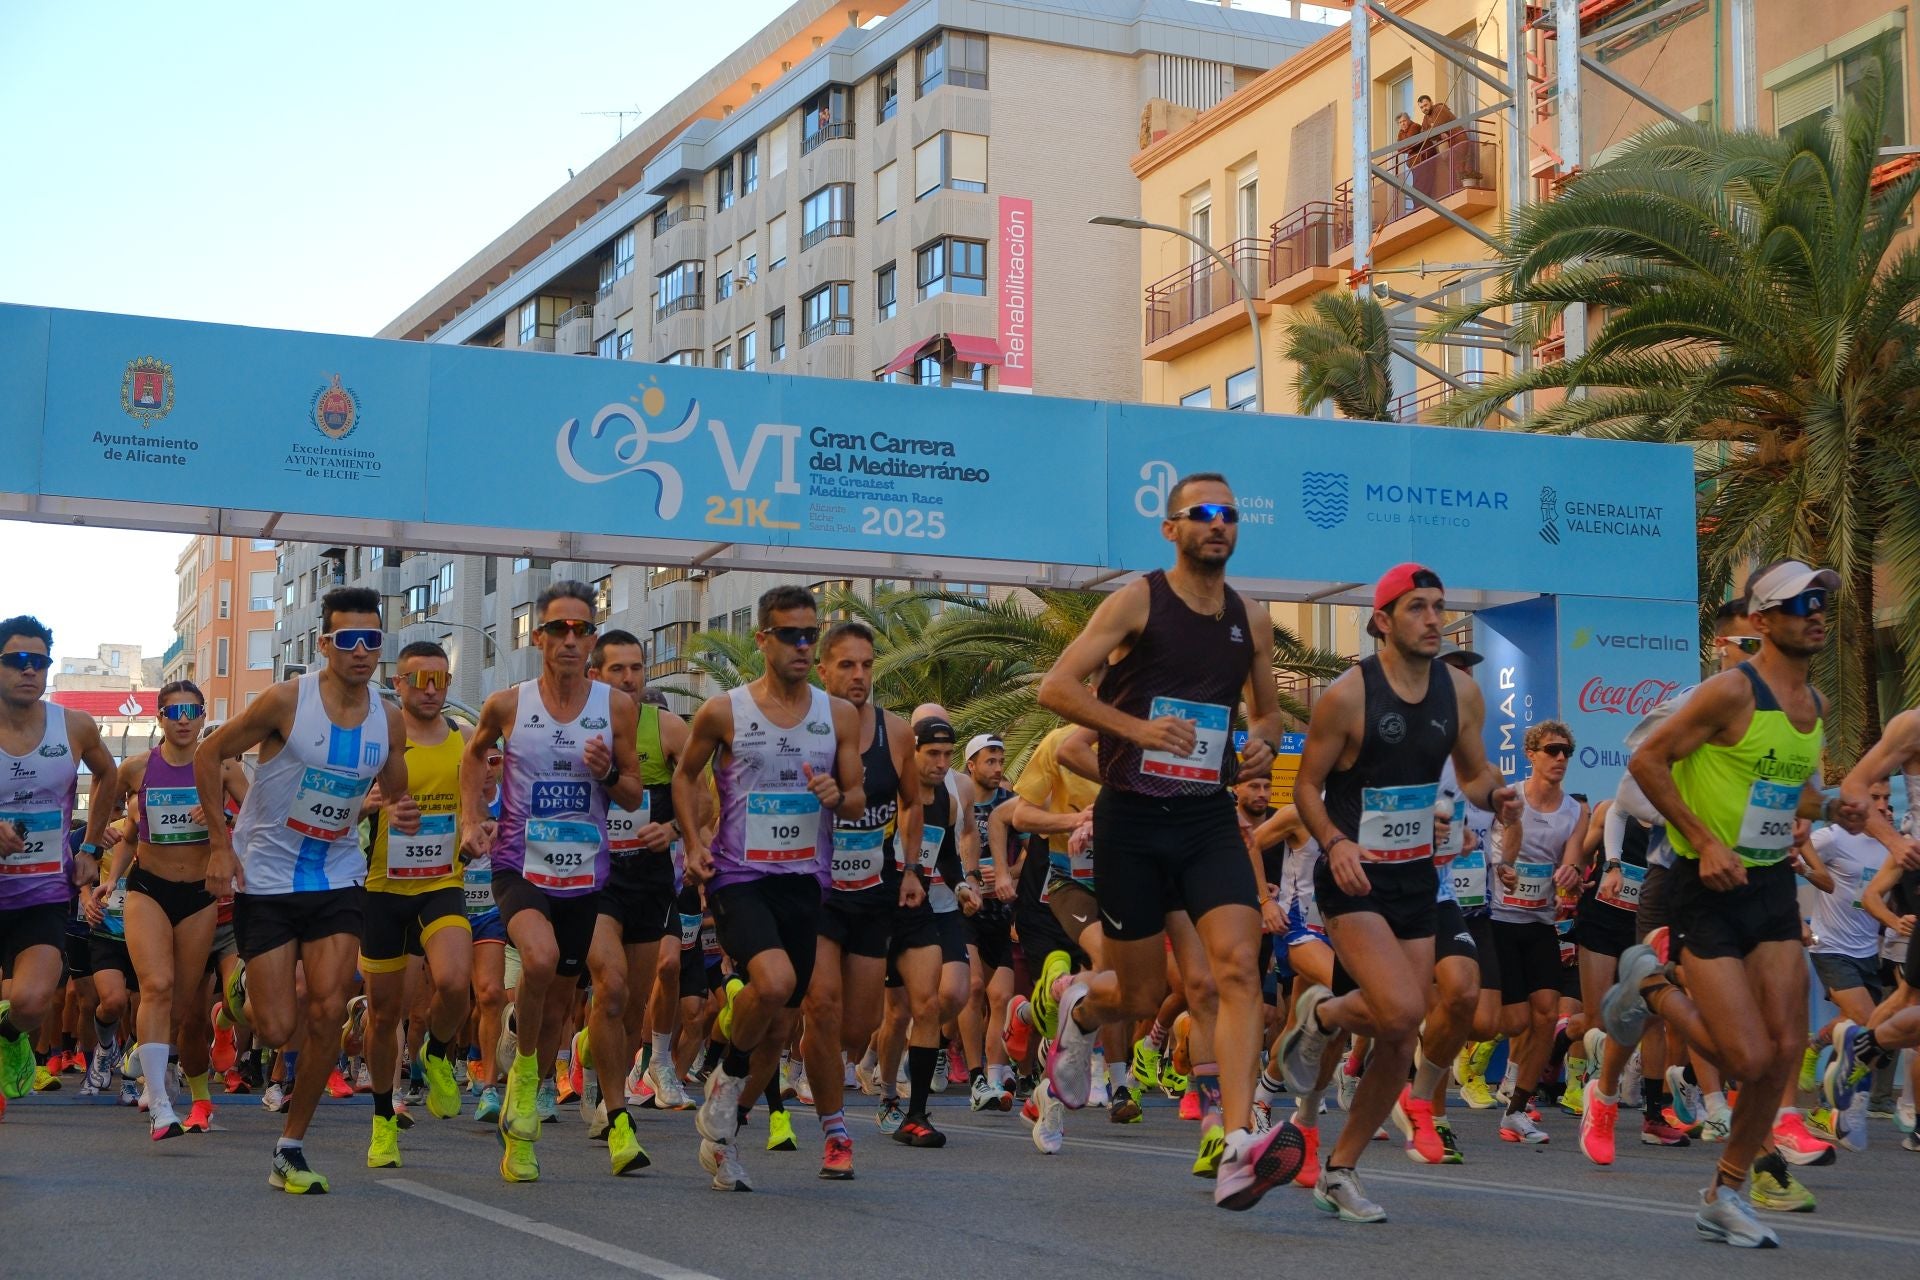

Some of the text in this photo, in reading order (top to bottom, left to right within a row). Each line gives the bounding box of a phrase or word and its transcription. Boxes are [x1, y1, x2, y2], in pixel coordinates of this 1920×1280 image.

[1004, 210, 1024, 369] Rehabilitación
[92, 431, 199, 452] Ayuntamiento
[809, 427, 956, 457] Gran Carrera
[103, 448, 187, 466] de Alicante
[285, 455, 382, 471] AYUNTAMIENTO
[708, 420, 801, 495] VI
[306, 467, 360, 480] de ELCHE
[809, 452, 990, 484] del Mediterráneo
[809, 473, 895, 491] The Greatest
[809, 486, 944, 505] Mediterranean Race
[1235, 496, 1274, 509] ACIÓN
[1366, 484, 1509, 511] MONTEMAR
[705, 496, 801, 530] 21K
[809, 503, 847, 514] Alicante
[1565, 502, 1663, 521] GENERALITAT
[809, 513, 834, 522] Elche
[861, 506, 946, 539] 2025
[1241, 514, 1274, 525] ANTE
[1367, 511, 1472, 529] CLUB ATLÉTICO
[809, 522, 857, 533] Santa Pola
[1566, 519, 1662, 537] VALENCIANA
[1596, 633, 1689, 652] vectalia
[1579, 676, 1681, 716] Coca-Col
[1500, 666, 1516, 776] EMAR
[1601, 750, 1621, 767] HLA
[536, 785, 587, 797] AQUA
[310, 803, 351, 820] 4038
[539, 798, 584, 809] DEUS
[605, 819, 633, 831] 350
[771, 825, 800, 839] 109
[1382, 822, 1421, 838] 2019
[405, 844, 442, 857] 3362
[543, 853, 583, 866] 4923
[831, 859, 871, 871] 3080
[464, 890, 490, 899] 2539
[1519, 883, 1540, 893] 3711
